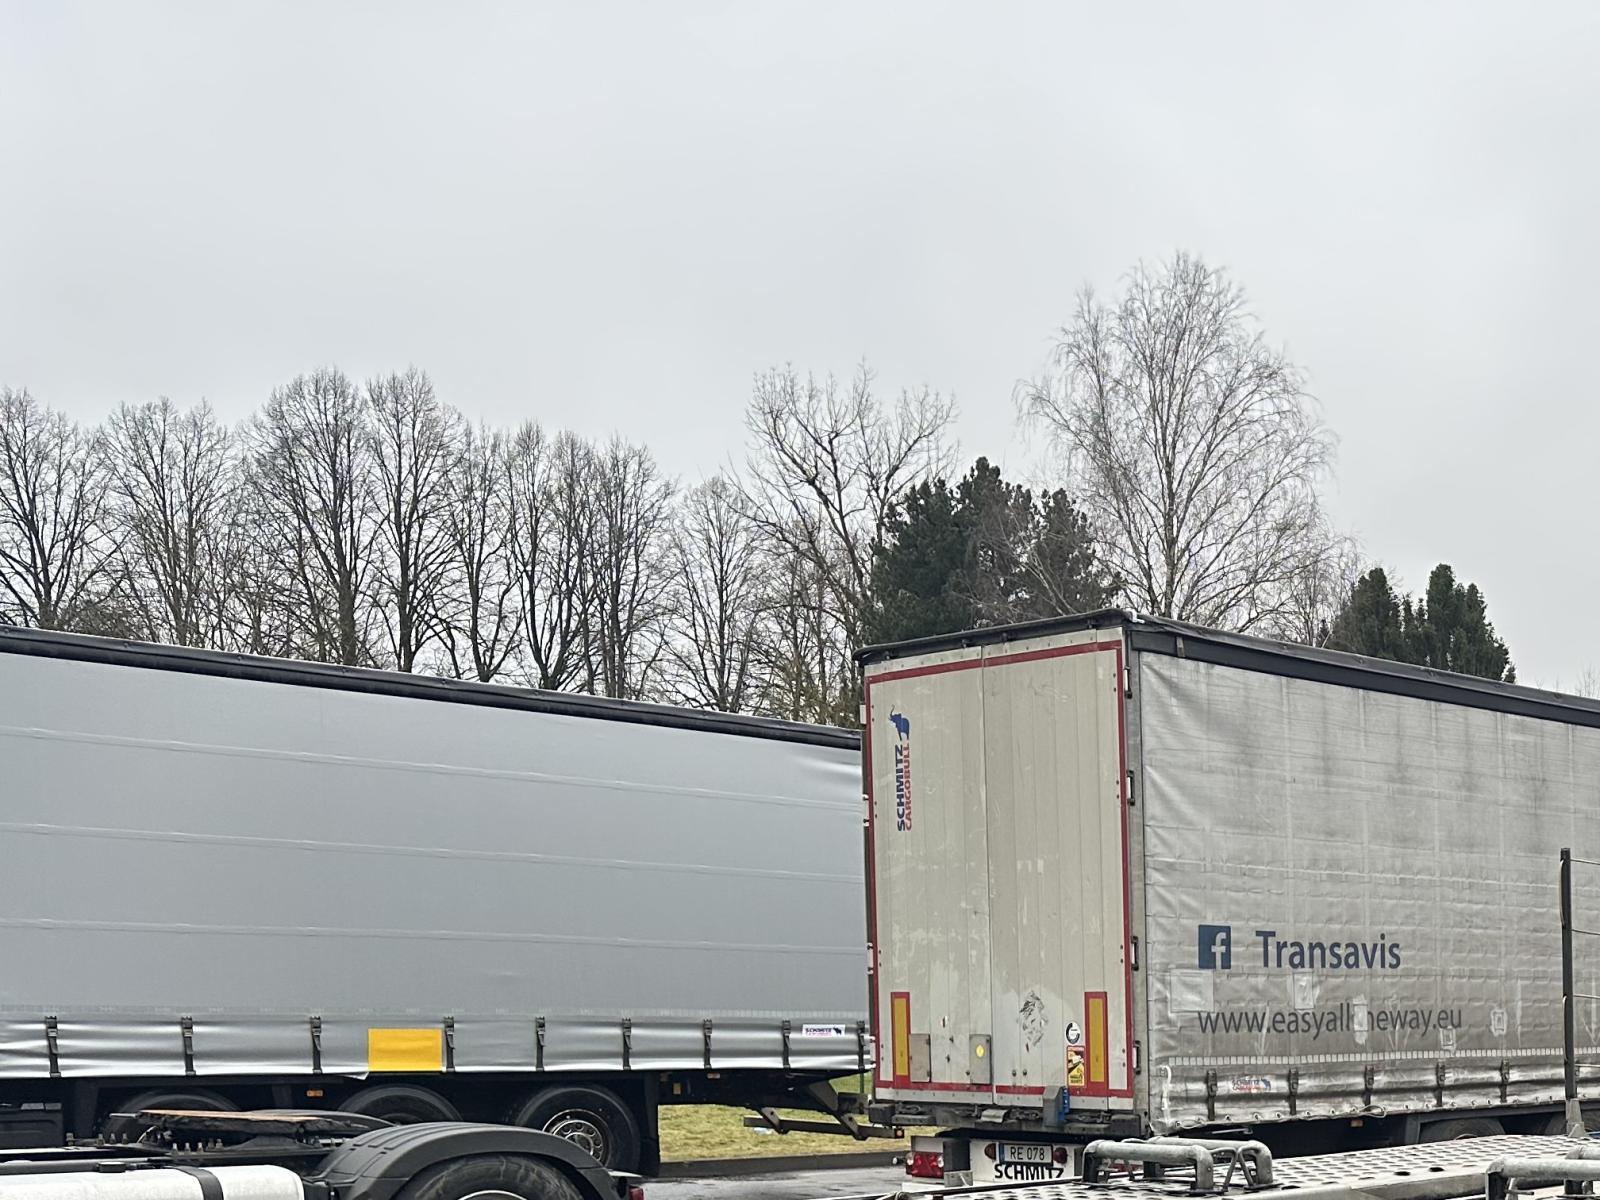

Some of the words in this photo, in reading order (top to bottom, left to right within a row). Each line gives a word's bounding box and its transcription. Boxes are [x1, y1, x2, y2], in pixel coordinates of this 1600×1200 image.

[895, 744, 905, 831] SCHMITZ
[903, 743, 912, 831] CARGOBULL
[1255, 930, 1401, 969] Transavis
[1199, 1003, 1462, 1040] www.easyallneway.eu
[994, 1164, 1064, 1180] SCHMITZ
[1010, 1147, 1023, 1160] RE
[1027, 1147, 1045, 1160] 078
